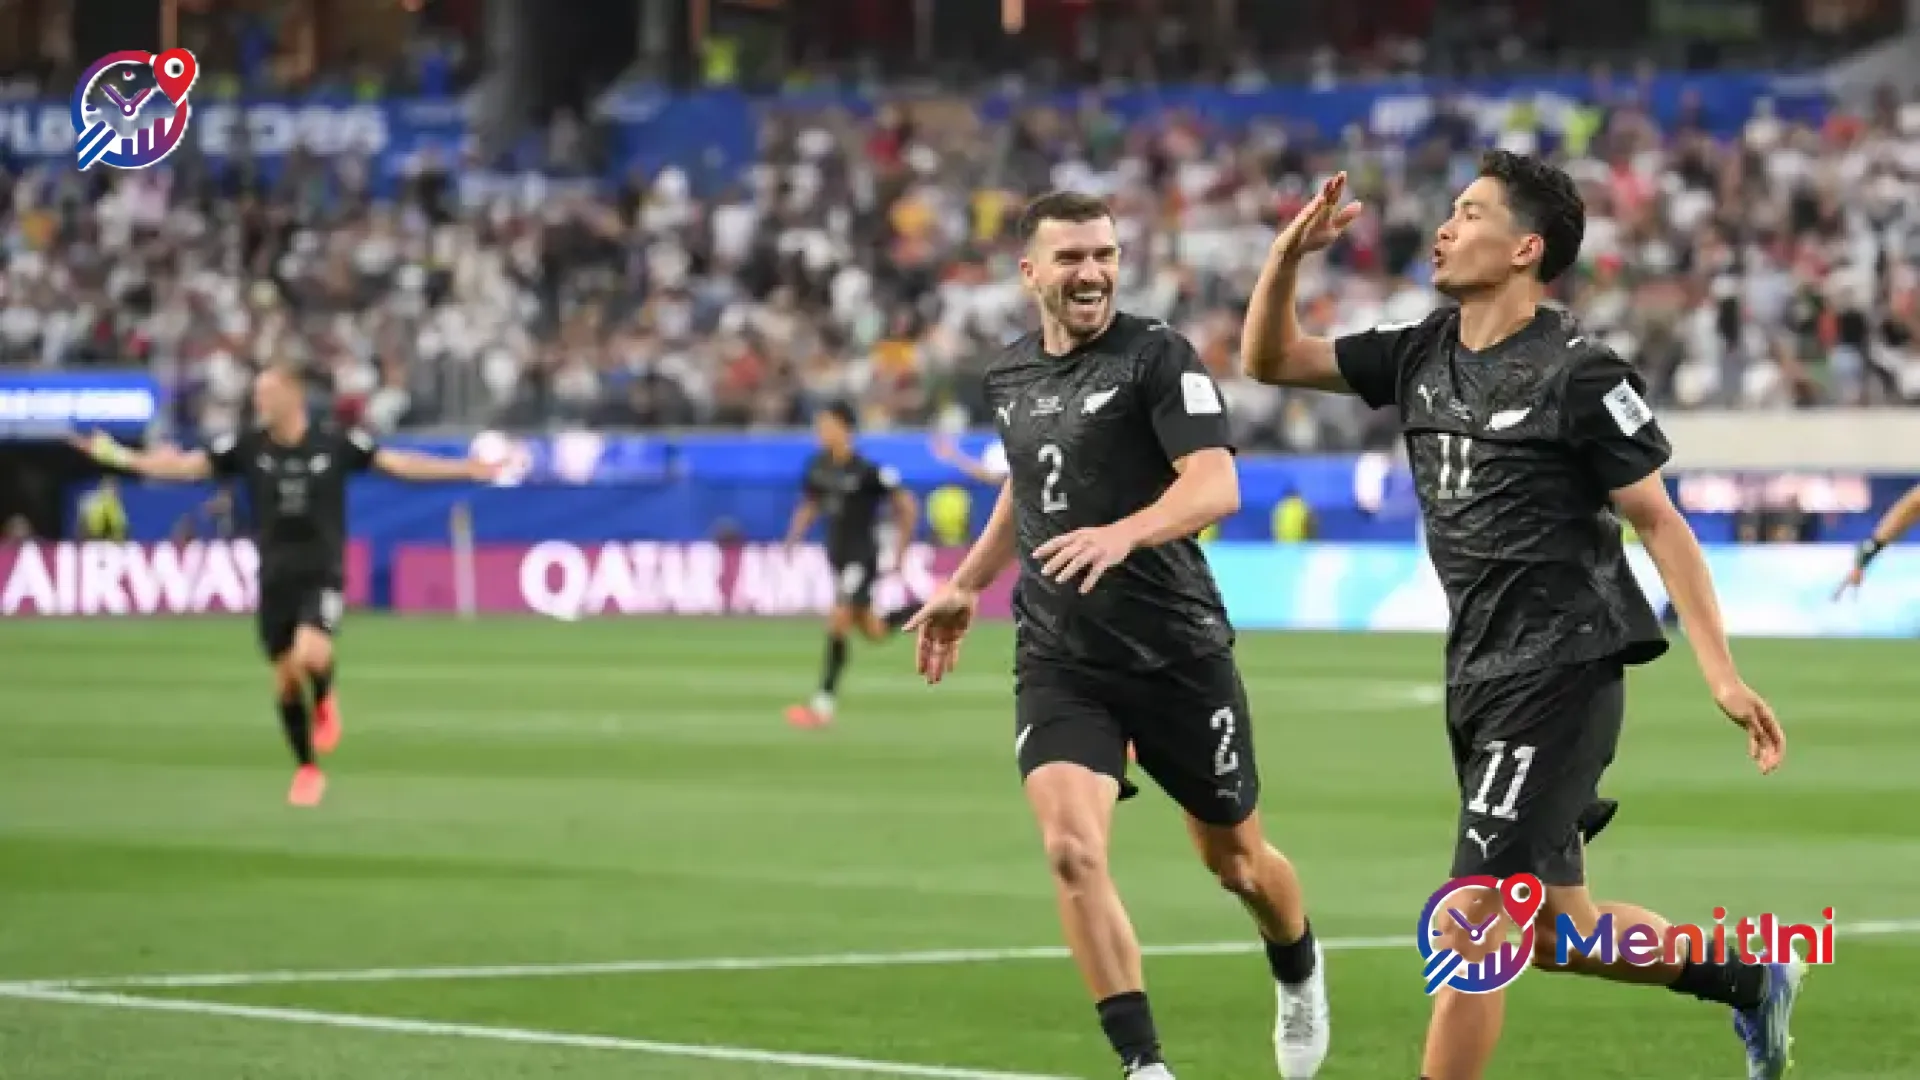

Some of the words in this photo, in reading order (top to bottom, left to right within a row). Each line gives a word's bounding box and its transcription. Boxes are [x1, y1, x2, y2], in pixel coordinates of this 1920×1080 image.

[1037, 444, 1068, 513] 2
[1437, 432, 1473, 499] 11
[0, 539, 261, 615] AIRWAY
[1209, 706, 1239, 775] 2
[1468, 740, 1537, 820] 11
